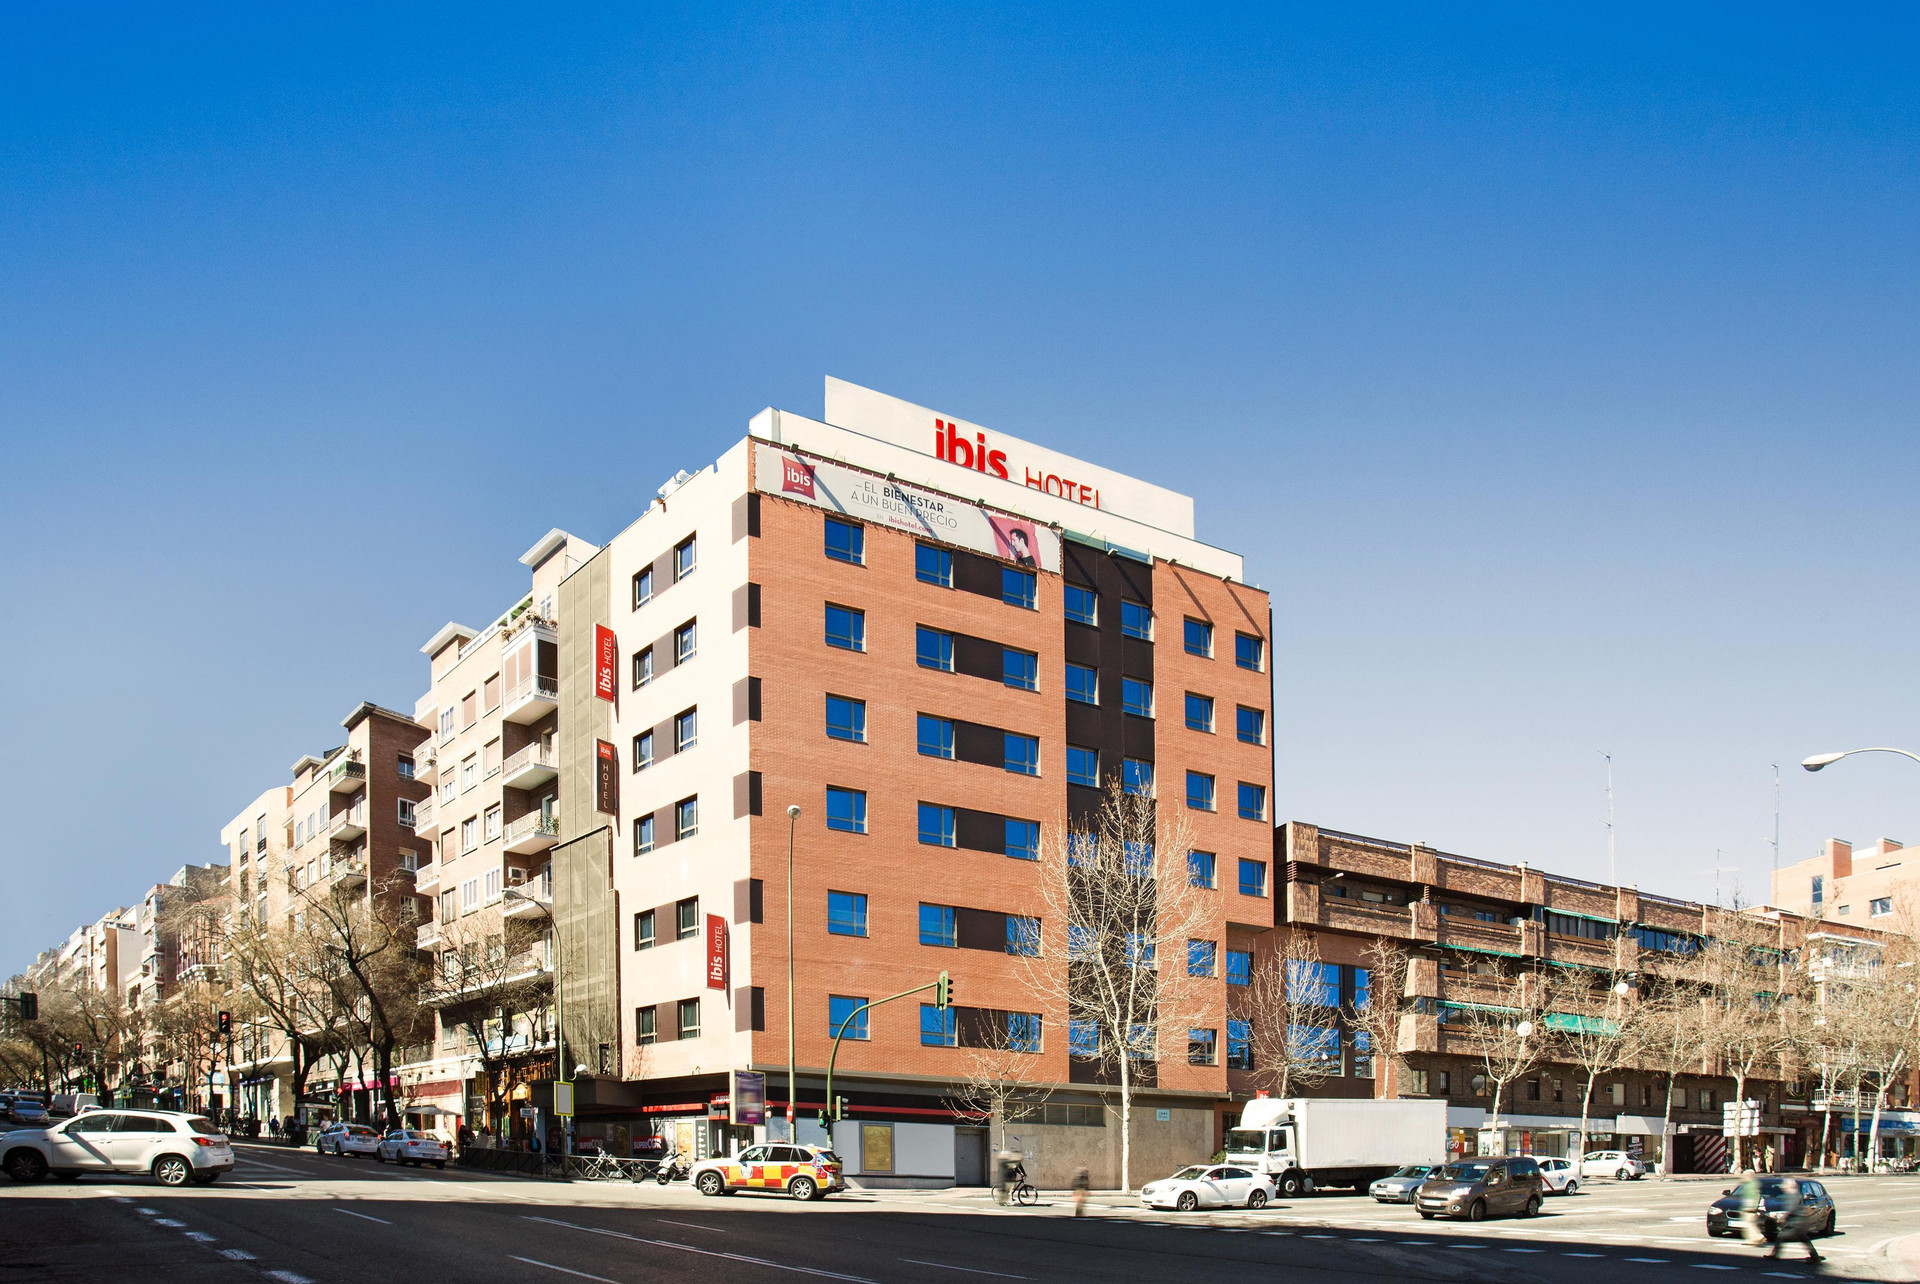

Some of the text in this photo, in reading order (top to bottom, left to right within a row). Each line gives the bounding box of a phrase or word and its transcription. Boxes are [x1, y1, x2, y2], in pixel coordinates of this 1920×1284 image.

[935, 418, 1099, 509] ibis HOTEL
[786, 466, 811, 487] ibis
[864, 481, 944, 513] EL BIENESTAR
[850, 491, 958, 529] A UN BUEN PRECIO
[888, 515, 933, 534] ibishotel.com
[600, 667, 611, 692] ibis
[600, 745, 611, 756] ibis
[711, 956, 722, 980] ibis
